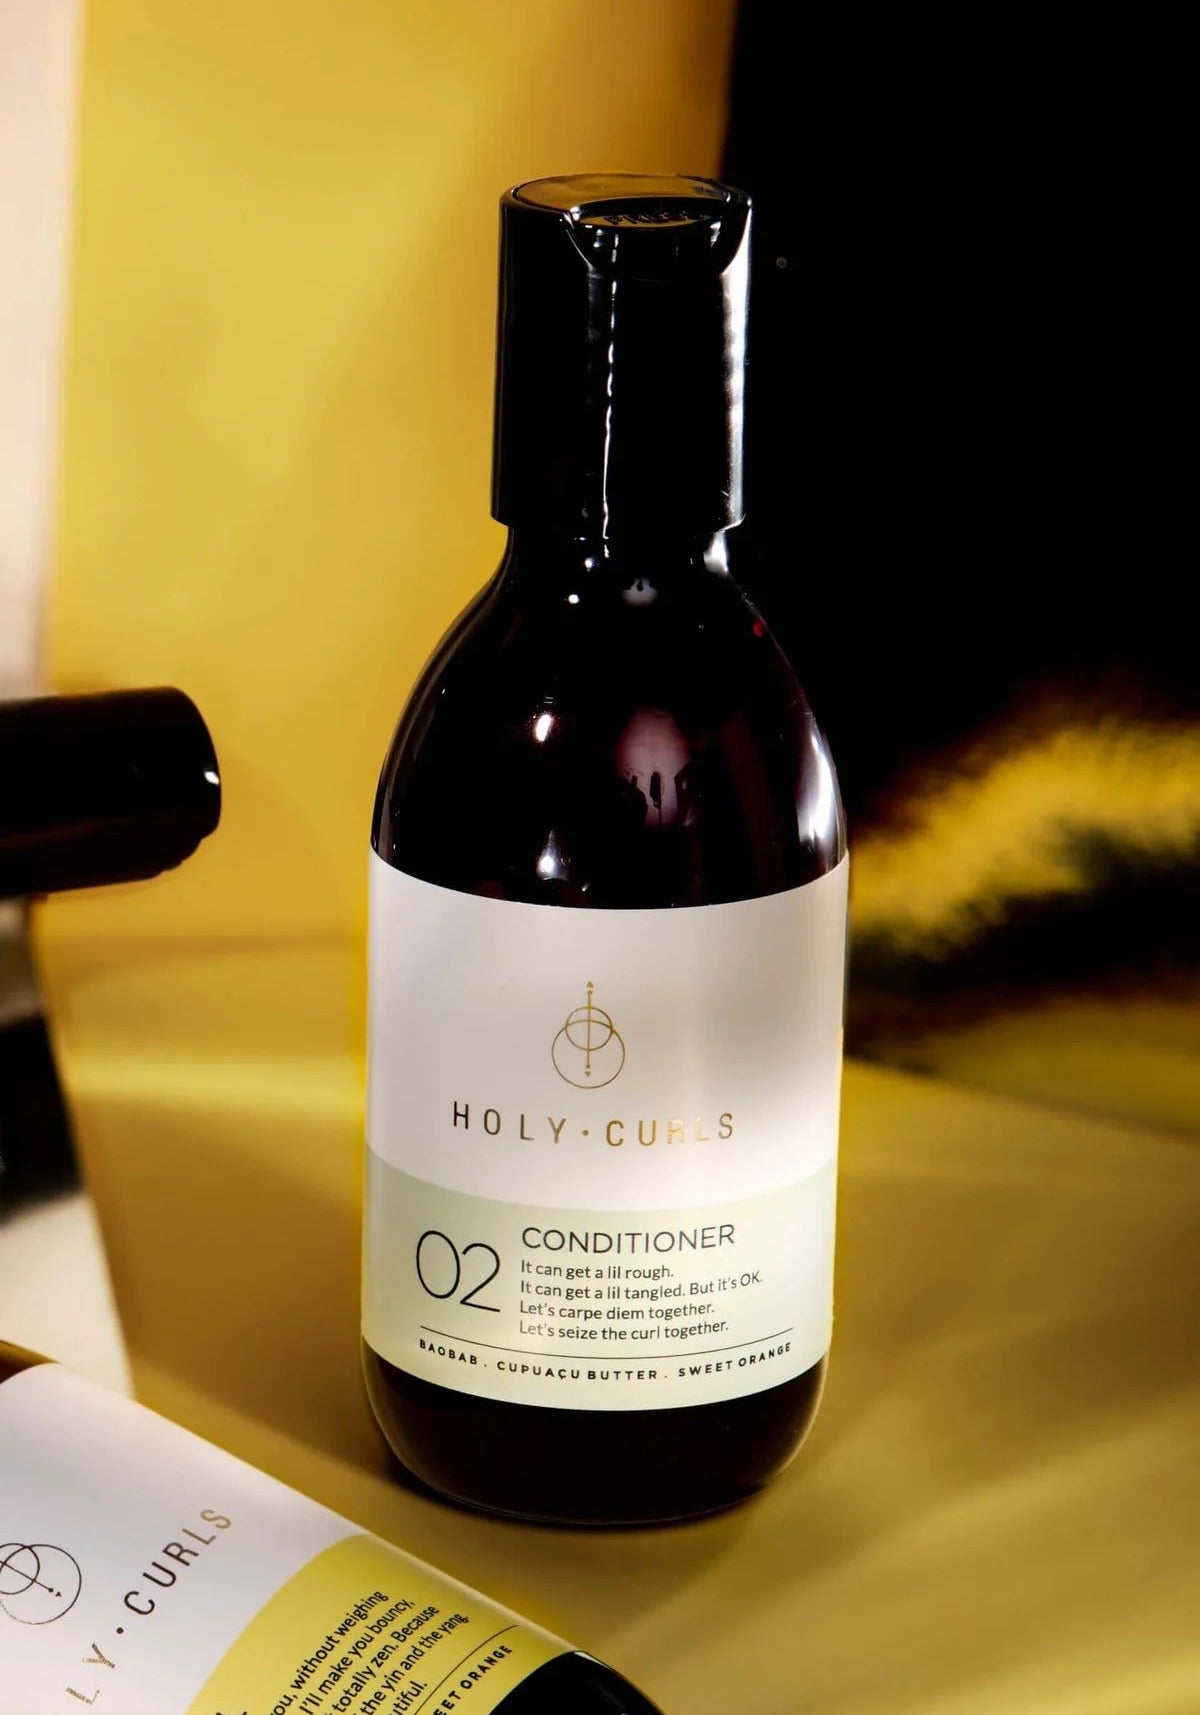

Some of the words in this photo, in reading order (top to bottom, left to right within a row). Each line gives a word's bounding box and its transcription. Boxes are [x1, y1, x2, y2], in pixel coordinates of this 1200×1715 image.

[522, 1224, 735, 1254] CONDITIONER
[416, 1230, 500, 1313] 02
[520, 1280, 532, 1293] It
[535, 1284, 562, 1297] can
[565, 1287, 591, 1301] get
[594, 1289, 603, 1300] a
[607, 1286, 621, 1300] lil
[624, 1285, 685, 1301] tangled.
[689, 1281, 714, 1296] But
[718, 1277, 737, 1292] it's
[740, 1270, 763, 1287] OK.
[521, 1260, 532, 1273] It
[535, 1264, 562, 1277] can
[565, 1267, 591, 1280] get
[595, 1269, 604, 1279] a
[608, 1266, 621, 1280] lil
[625, 1265, 674, 1281] rough.
[519, 1320, 555, 1337] Let's
[558, 1325, 598, 1339] seize
[602, 1325, 627, 1340] the
[631, 1324, 660, 1340] curl
[664, 1320, 729, 1339] together.
[520, 1300, 555, 1316] Let's
[559, 1307, 602, 1321] carpe
[606, 1306, 644, 1320] diem
[649, 1303, 715, 1321] together.
[497, 1361, 580, 1379] CUPUAÇU
[678, 1360, 733, 1377] SWEET
[738, 1342, 791, 1367] ORANGE
[270, 1695, 299, 1715] ou,
[290, 1635, 340, 1691] without
[334, 1591, 389, 1641] weighing
[299, 1692, 321, 1715] I'll
[318, 1656, 353, 1695] make
[349, 1634, 374, 1658] you
[369, 1599, 416, 1634] bouncy,
[332, 1665, 377, 1715] totally
[370, 1644, 400, 1668] zen.
[390, 1605, 440, 1644] Because
[360, 1690, 387, 1715] the
[381, 1669, 406, 1692] yin
[400, 1645, 425, 1671] and
[418, 1628, 444, 1650] the
[440, 1612, 470, 1634] yang.
[460, 1644, 512, 1690] ORANGE
